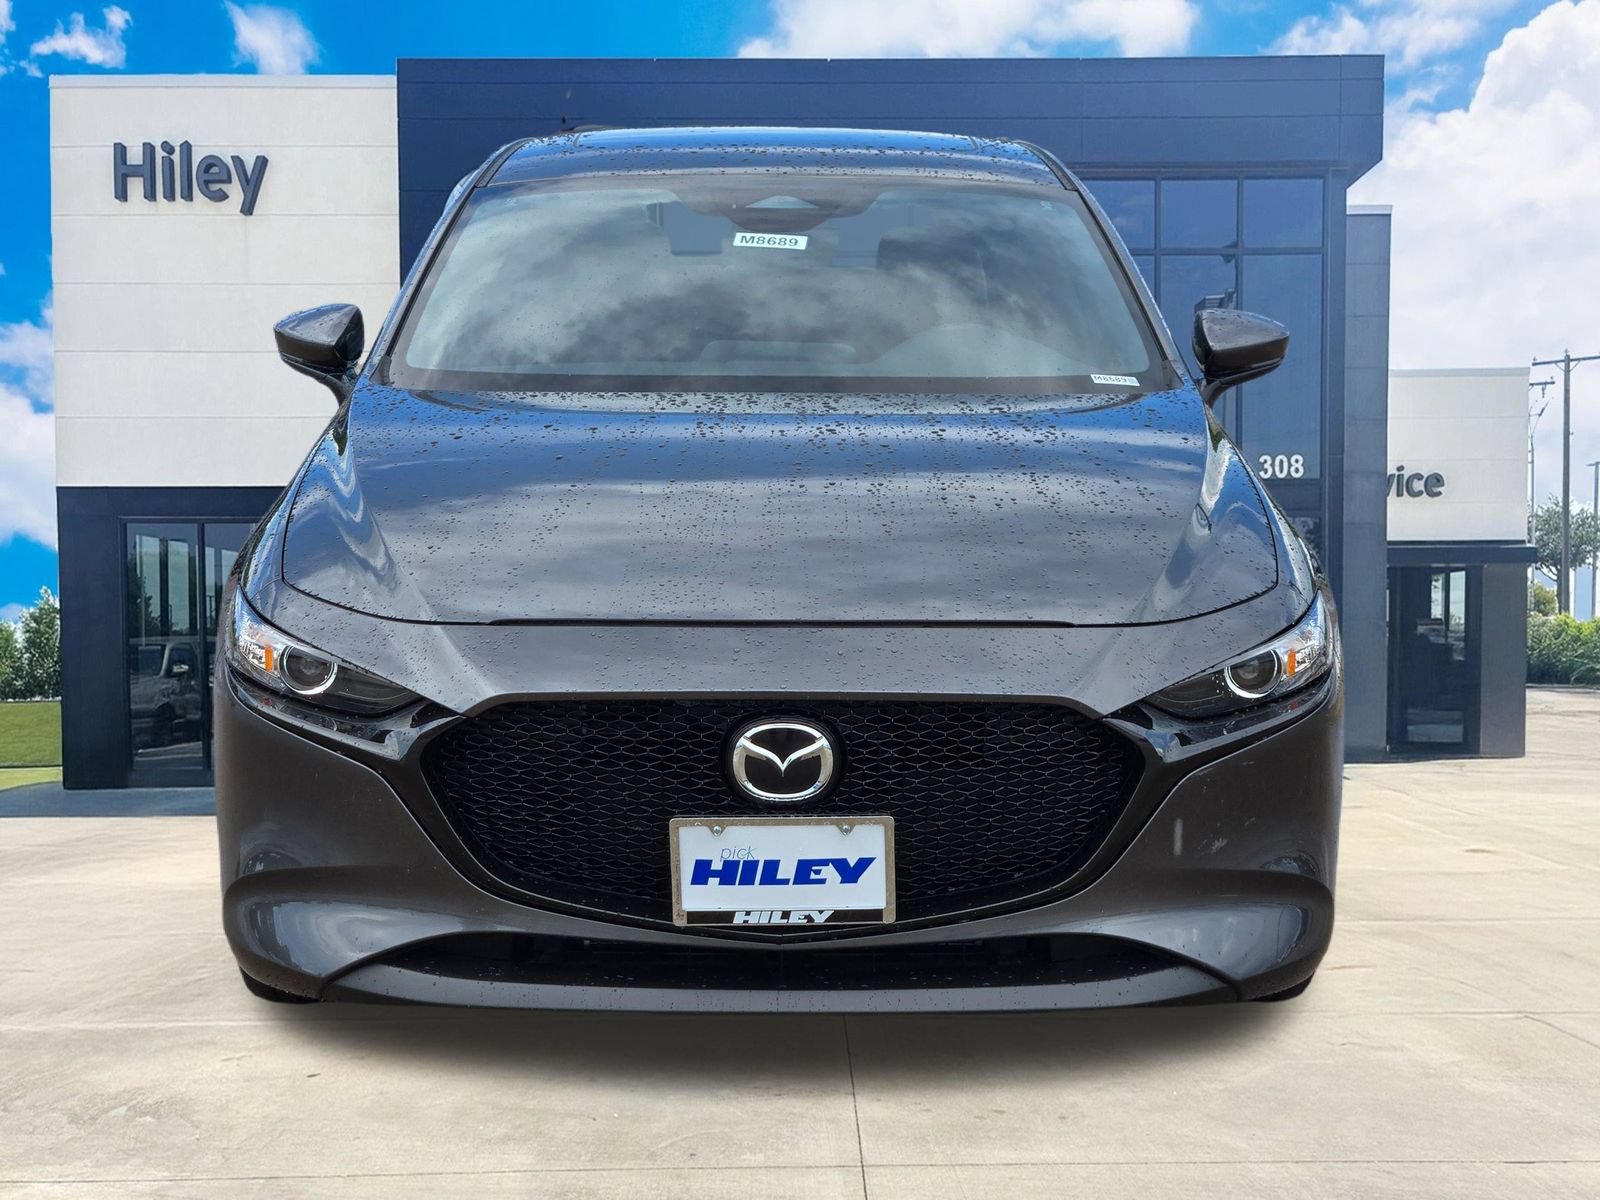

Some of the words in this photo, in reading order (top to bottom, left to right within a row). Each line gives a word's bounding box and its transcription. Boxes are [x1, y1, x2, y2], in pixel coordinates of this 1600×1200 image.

[113, 140, 269, 216] Hiley
[740, 235, 799, 247] M8689
[1259, 454, 1304, 479] 308
[720, 846, 756, 861] pick
[690, 857, 877, 886] HILEY
[732, 910, 834, 924] HILEY
